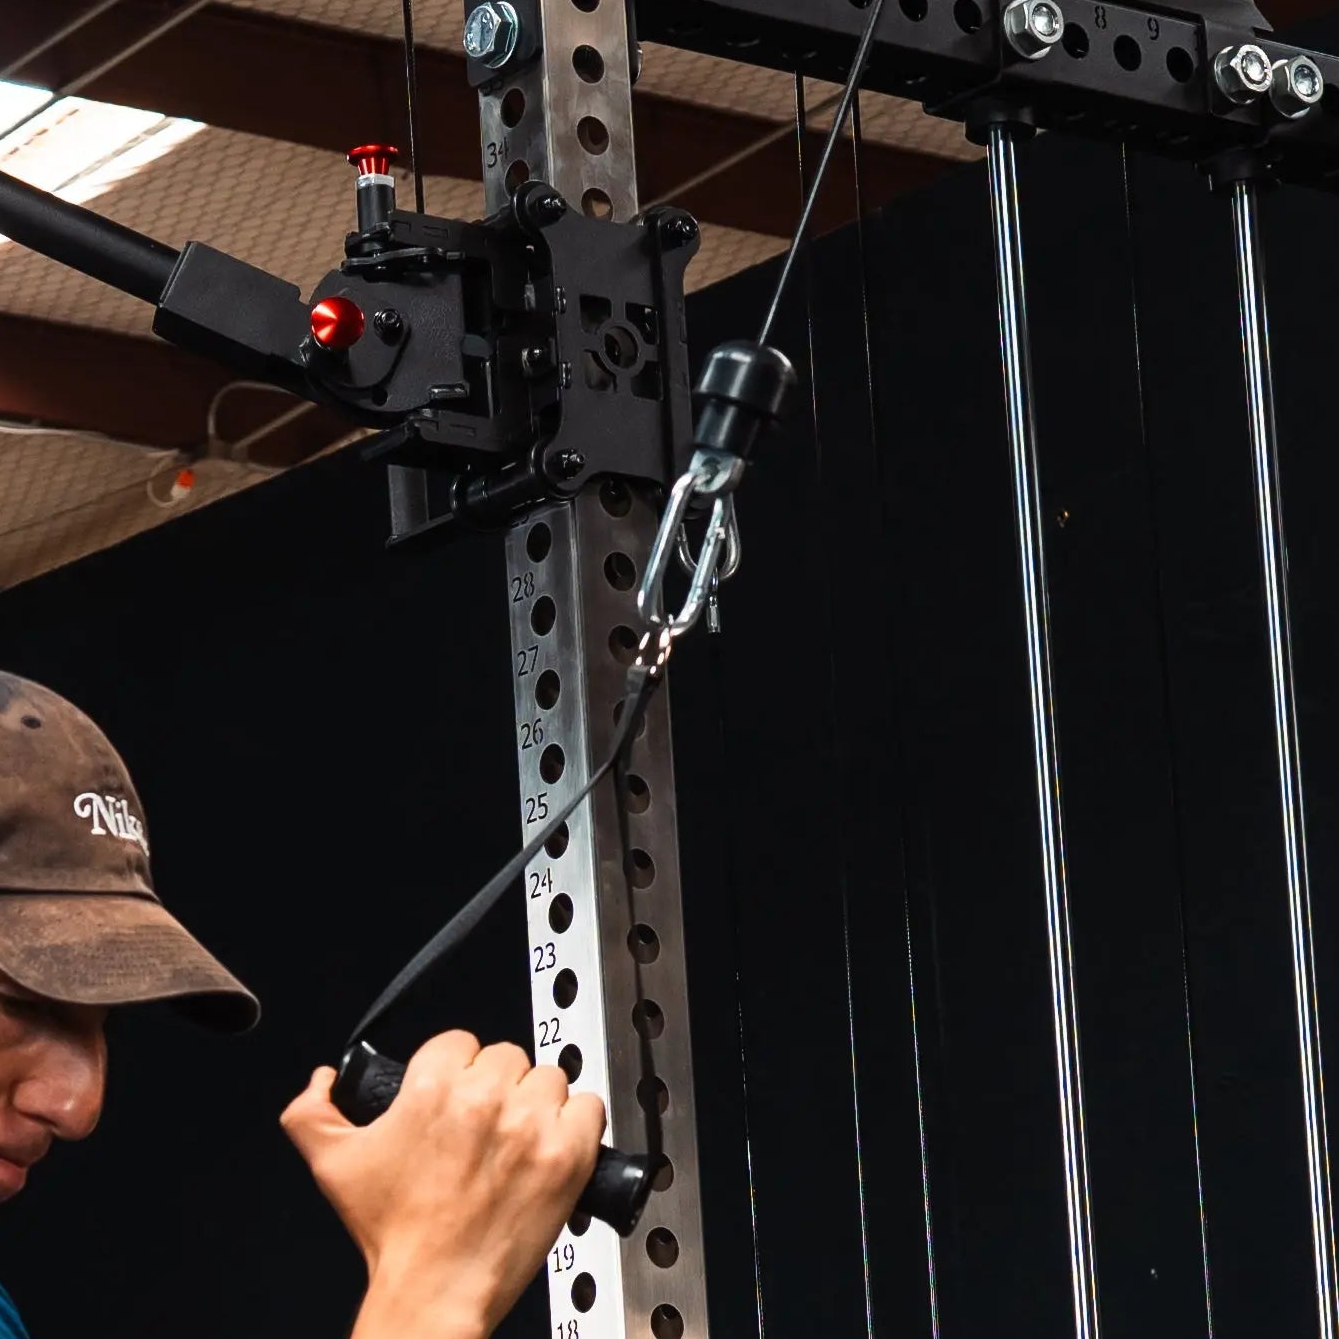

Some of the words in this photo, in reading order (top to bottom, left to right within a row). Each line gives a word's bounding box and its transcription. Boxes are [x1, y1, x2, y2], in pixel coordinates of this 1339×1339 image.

[1095, 5, 1107, 30] 8
[1147, 17, 1160, 40] 9
[487, 136, 510, 169] 34
[512, 571, 536, 603] 28
[516, 645, 540, 676] 27
[520, 718, 544, 751] 26
[525, 792, 548, 825] 25
[530, 867, 553, 899] 24
[534, 942, 556, 973] 23
[539, 1017, 562, 1048] 22
[552, 1243, 575, 1274] 19
